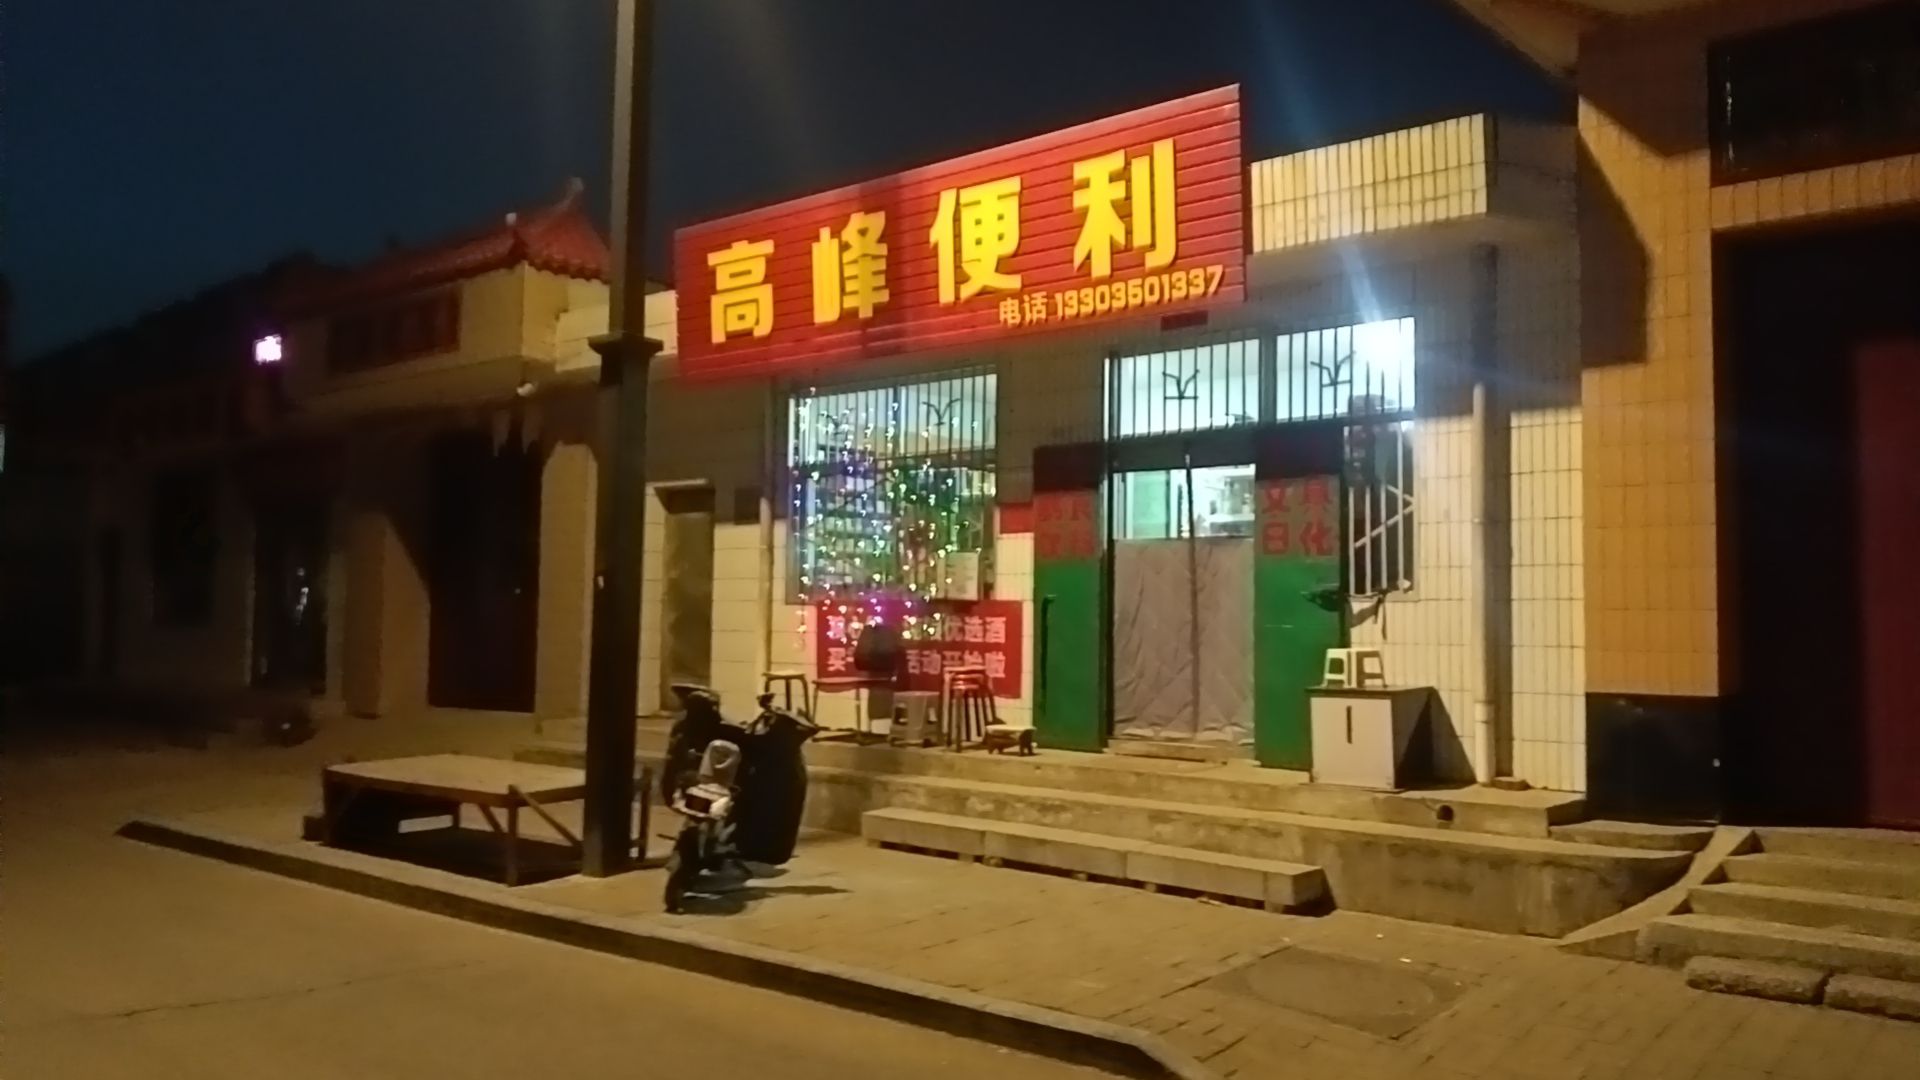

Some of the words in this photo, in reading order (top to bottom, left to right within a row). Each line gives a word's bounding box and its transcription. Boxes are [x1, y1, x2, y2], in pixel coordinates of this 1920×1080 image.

[707, 138, 1178, 344] 高峰便利
[999, 291, 1048, 326] 电话
[1054, 264, 1224, 319] 13303501337
[1262, 518, 1334, 557] 日化
